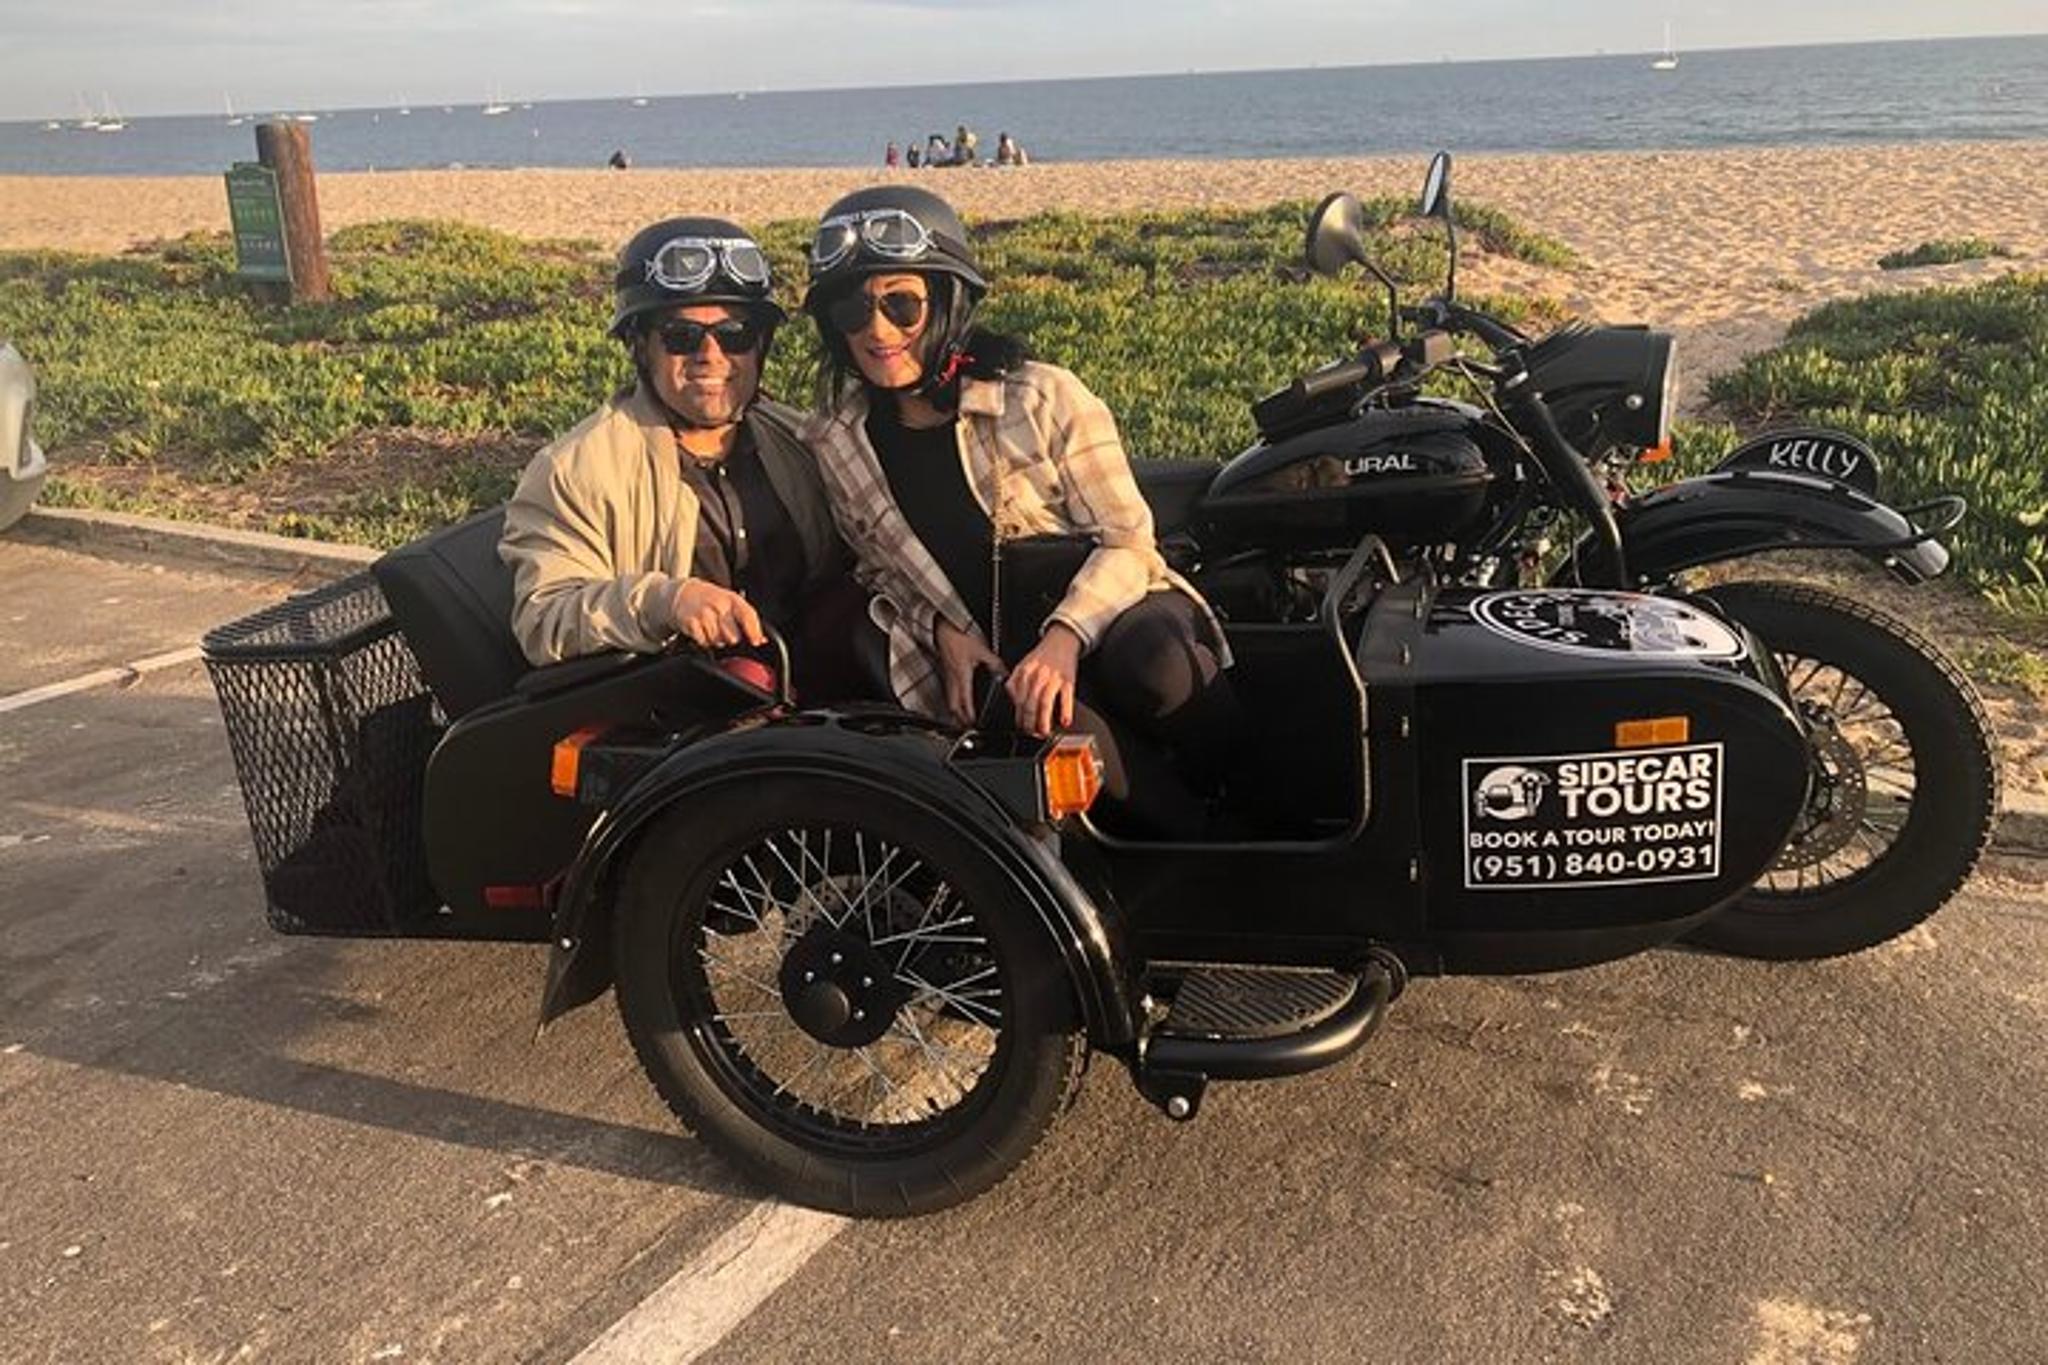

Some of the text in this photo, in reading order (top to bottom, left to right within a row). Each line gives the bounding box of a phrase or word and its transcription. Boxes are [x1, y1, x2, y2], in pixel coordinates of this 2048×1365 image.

[1344, 454, 1417, 475] URAL
[1769, 440, 1858, 478] KELLY
[1557, 753, 1713, 786] SIDECAR
[1558, 779, 1712, 818] TOURS
[1470, 820, 1715, 848] BOOK A TOUR TODAY!
[1472, 844, 1713, 881] (951) 840-0931
